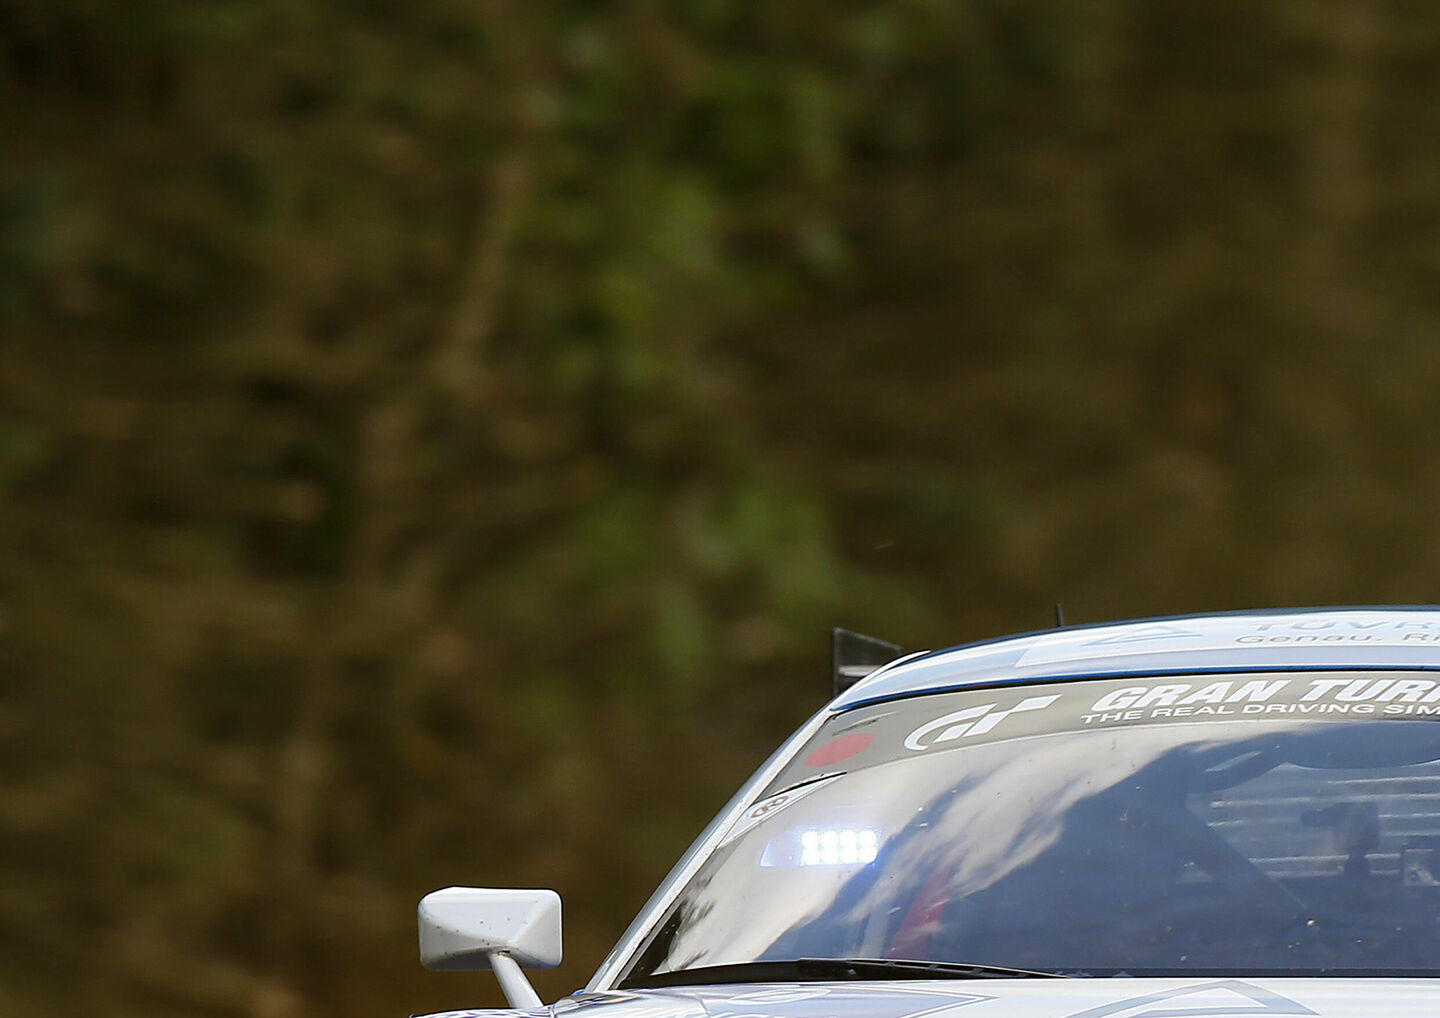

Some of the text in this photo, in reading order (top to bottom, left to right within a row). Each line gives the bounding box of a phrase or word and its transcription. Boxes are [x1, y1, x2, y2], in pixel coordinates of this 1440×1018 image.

[1090, 679, 1292, 712] GRAN
[1081, 712, 1148, 725] THE
[1150, 706, 1234, 719] REAL
[1242, 703, 1376, 715] DRIVING
